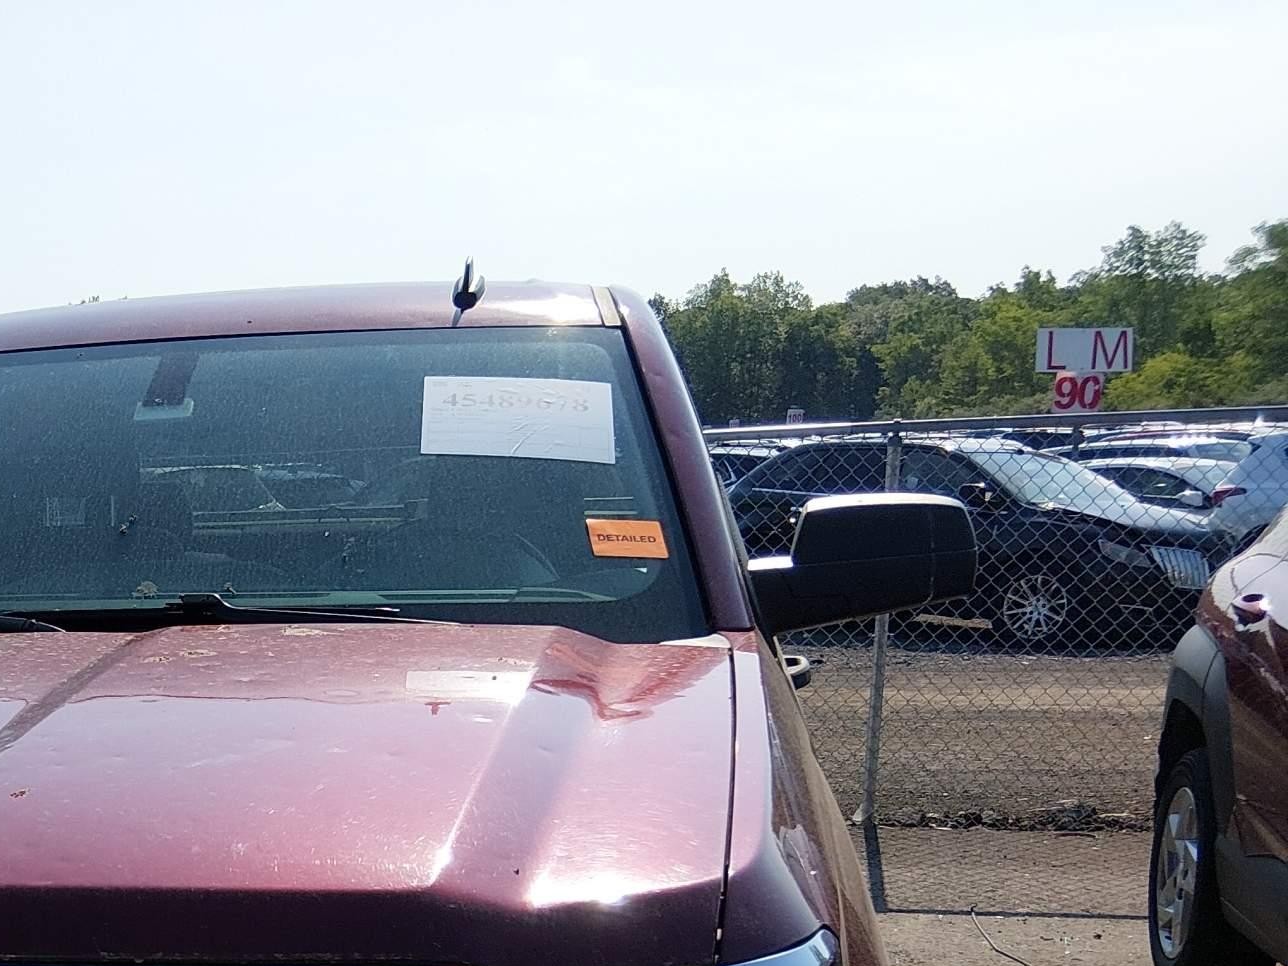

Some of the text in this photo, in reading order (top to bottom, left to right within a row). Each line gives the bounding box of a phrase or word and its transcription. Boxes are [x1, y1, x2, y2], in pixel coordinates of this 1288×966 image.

[1046, 330, 1129, 370] L M
[1053, 375, 1102, 410] 90
[596, 533, 657, 543] DETAILED
